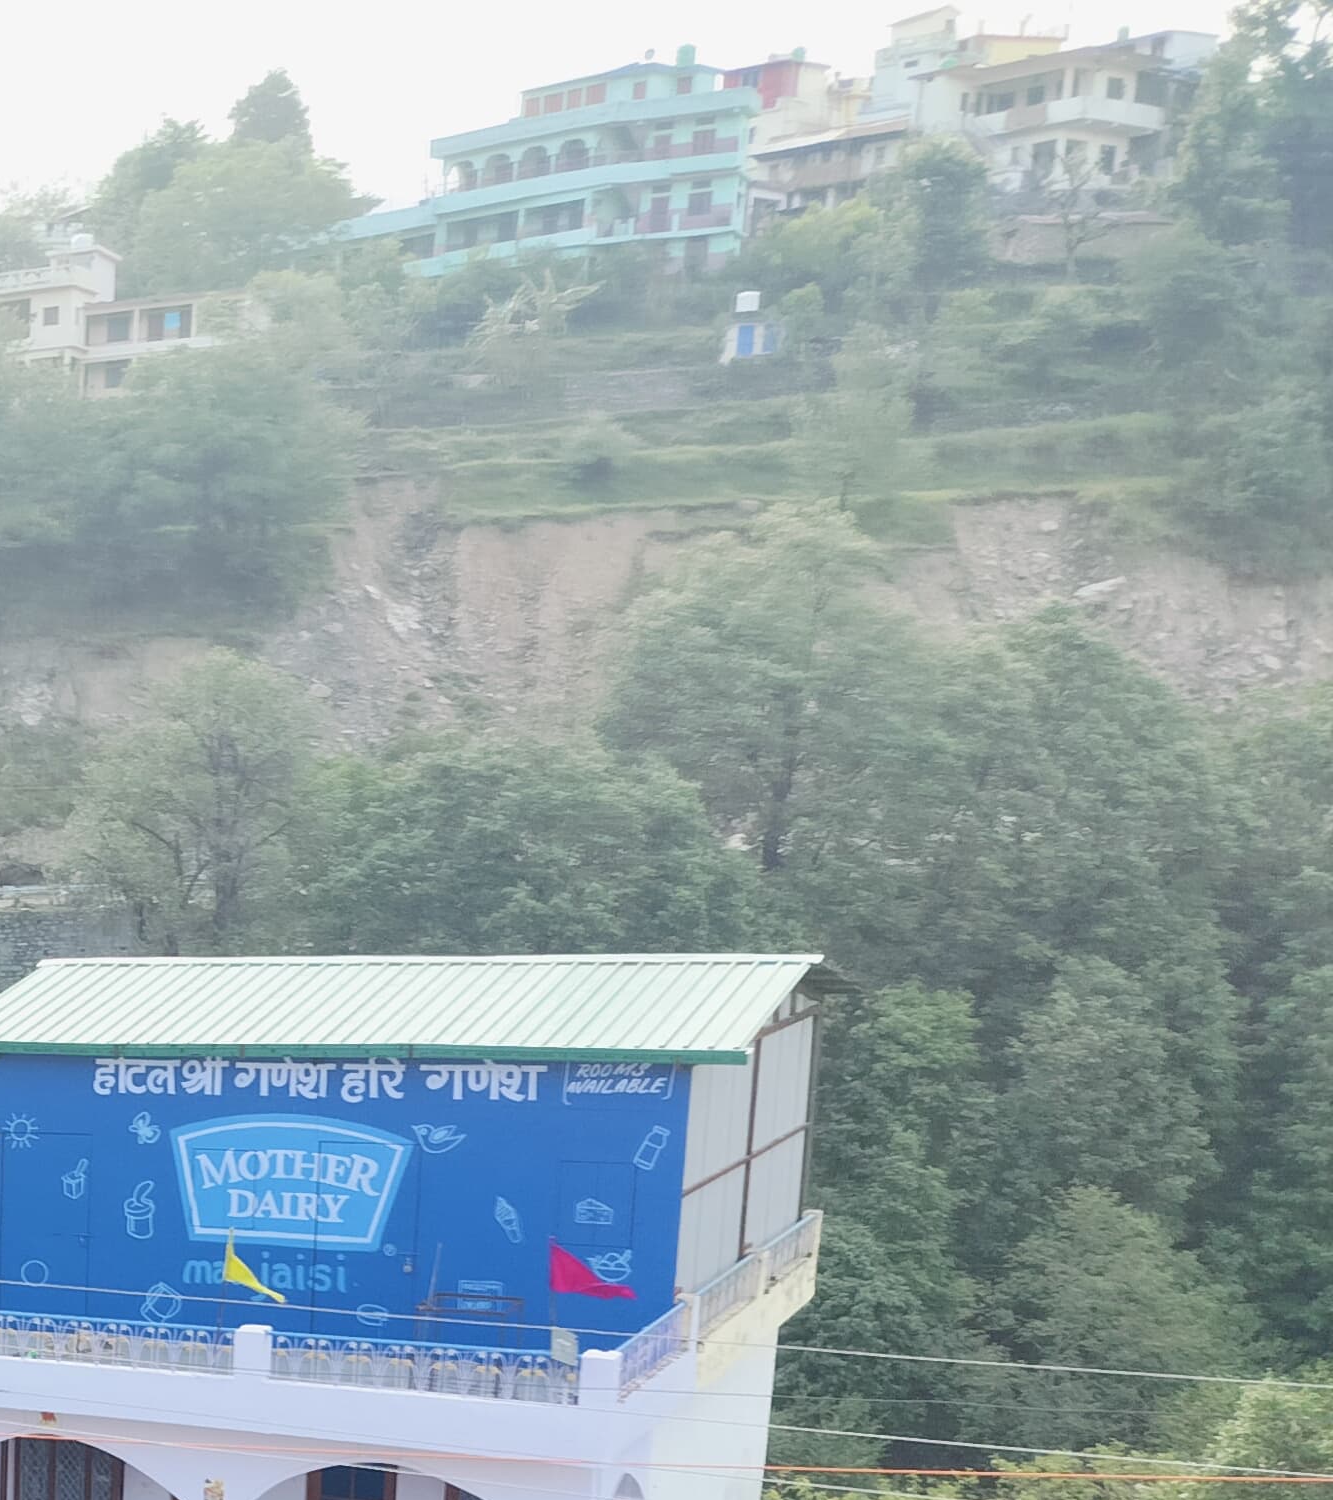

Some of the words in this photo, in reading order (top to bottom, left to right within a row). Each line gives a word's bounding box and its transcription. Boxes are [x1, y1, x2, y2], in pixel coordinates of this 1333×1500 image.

[234, 1058, 336, 1099] गणेश
[419, 1060, 548, 1101] गणेश
[566, 1077, 668, 1095] AVAILABLE
[577, 1062, 653, 1079] ROOMS
[195, 1148, 381, 1197] MOTHER
[227, 1189, 350, 1224] DAIRY
